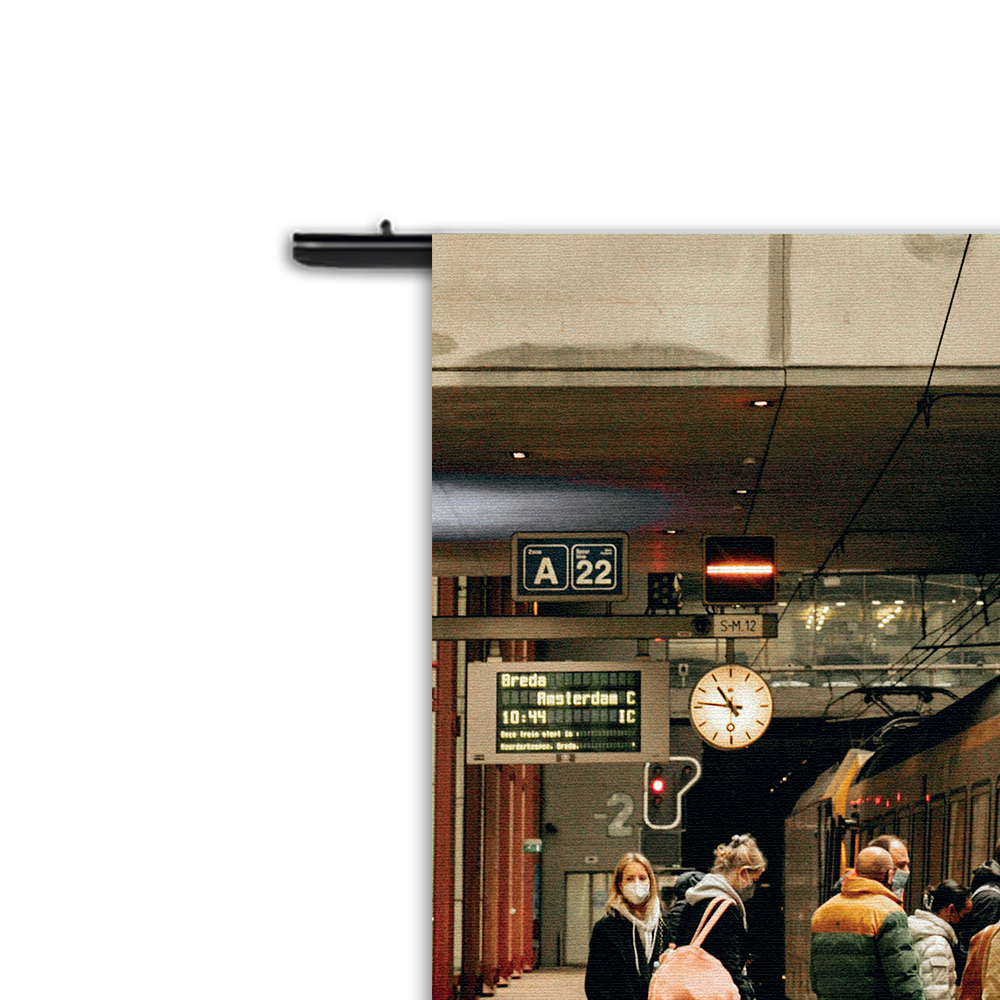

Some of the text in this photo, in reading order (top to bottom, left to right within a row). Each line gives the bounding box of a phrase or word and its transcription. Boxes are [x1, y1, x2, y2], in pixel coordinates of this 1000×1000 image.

[534, 557, 559, 585] A
[576, 559, 612, 585] 22
[501, 673, 547, 688] Breda
[537, 690, 636, 706] Amsterdam C
[503, 709, 636, 724] 10:44 IC
